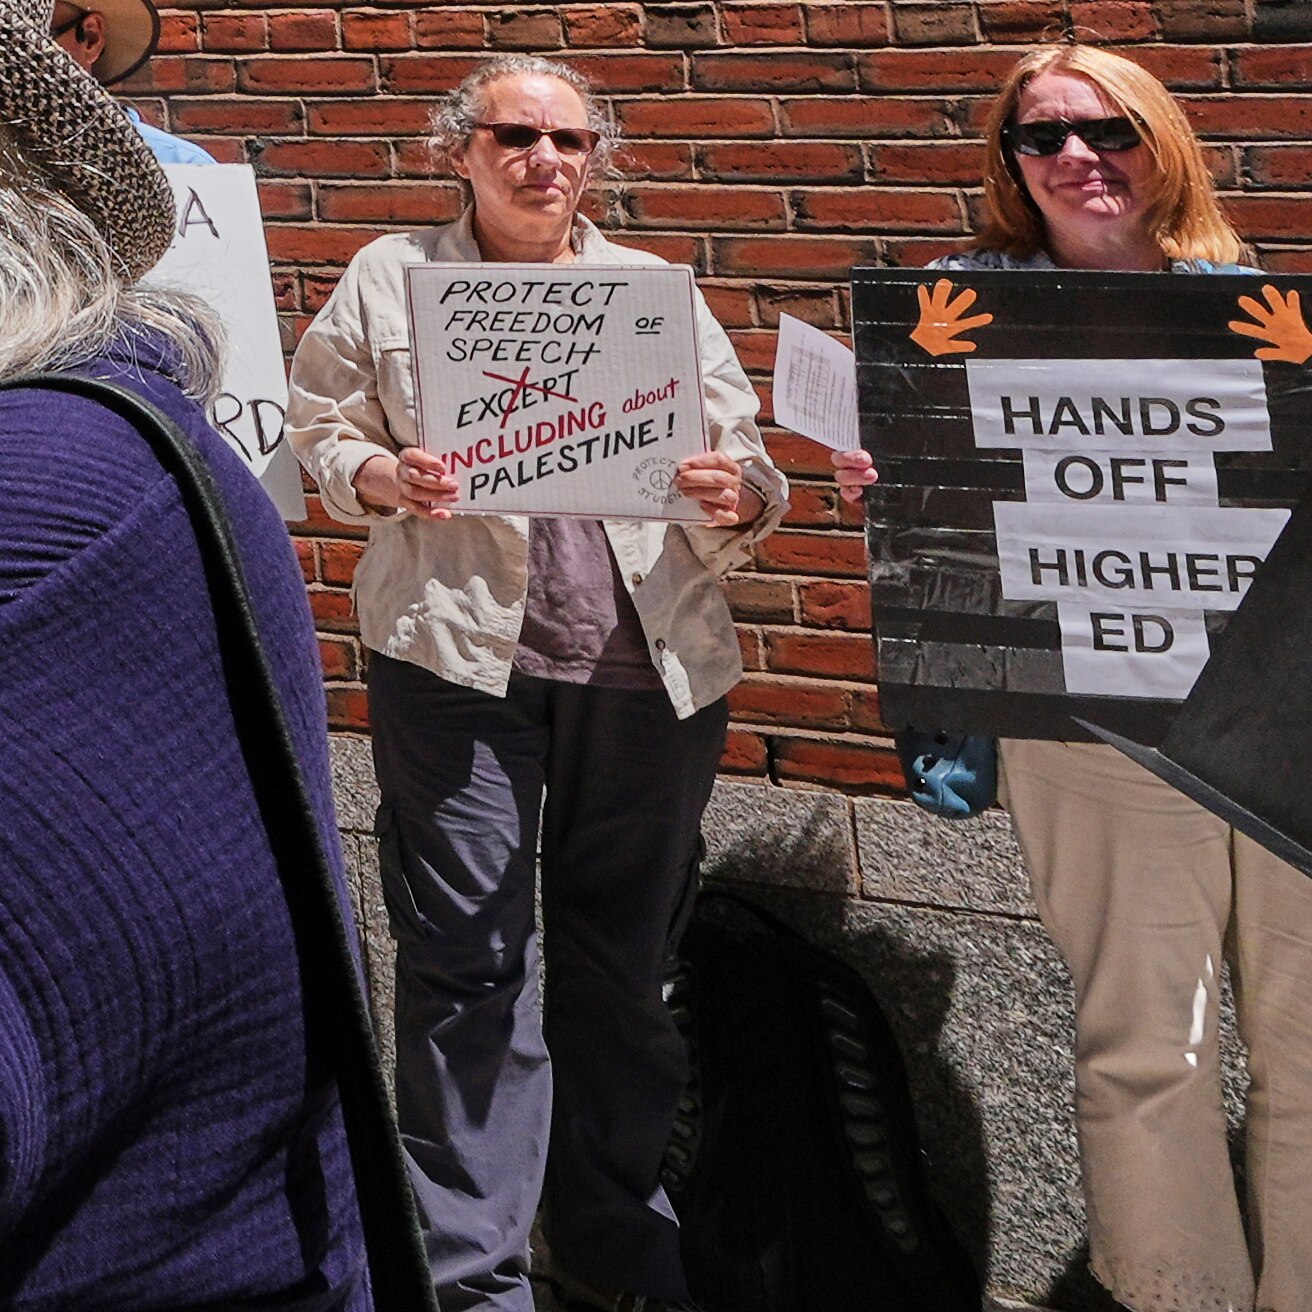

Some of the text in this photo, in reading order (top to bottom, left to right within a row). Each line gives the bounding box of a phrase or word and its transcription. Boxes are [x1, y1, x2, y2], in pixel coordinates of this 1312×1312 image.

[439, 280, 629, 306] PROTECT
[444, 310, 665, 336] FREEDOM OF
[446, 338, 601, 365] SPEECH
[456, 369, 580, 429] EXCEPT
[622, 377, 680, 414] about
[1000, 396, 1226, 437] HANDS
[469, 412, 675, 500] PALESTINE!
[632, 457, 677, 481] PROTECT
[1054, 455, 1188, 502] OFF
[1089, 611, 1175, 654] ED
